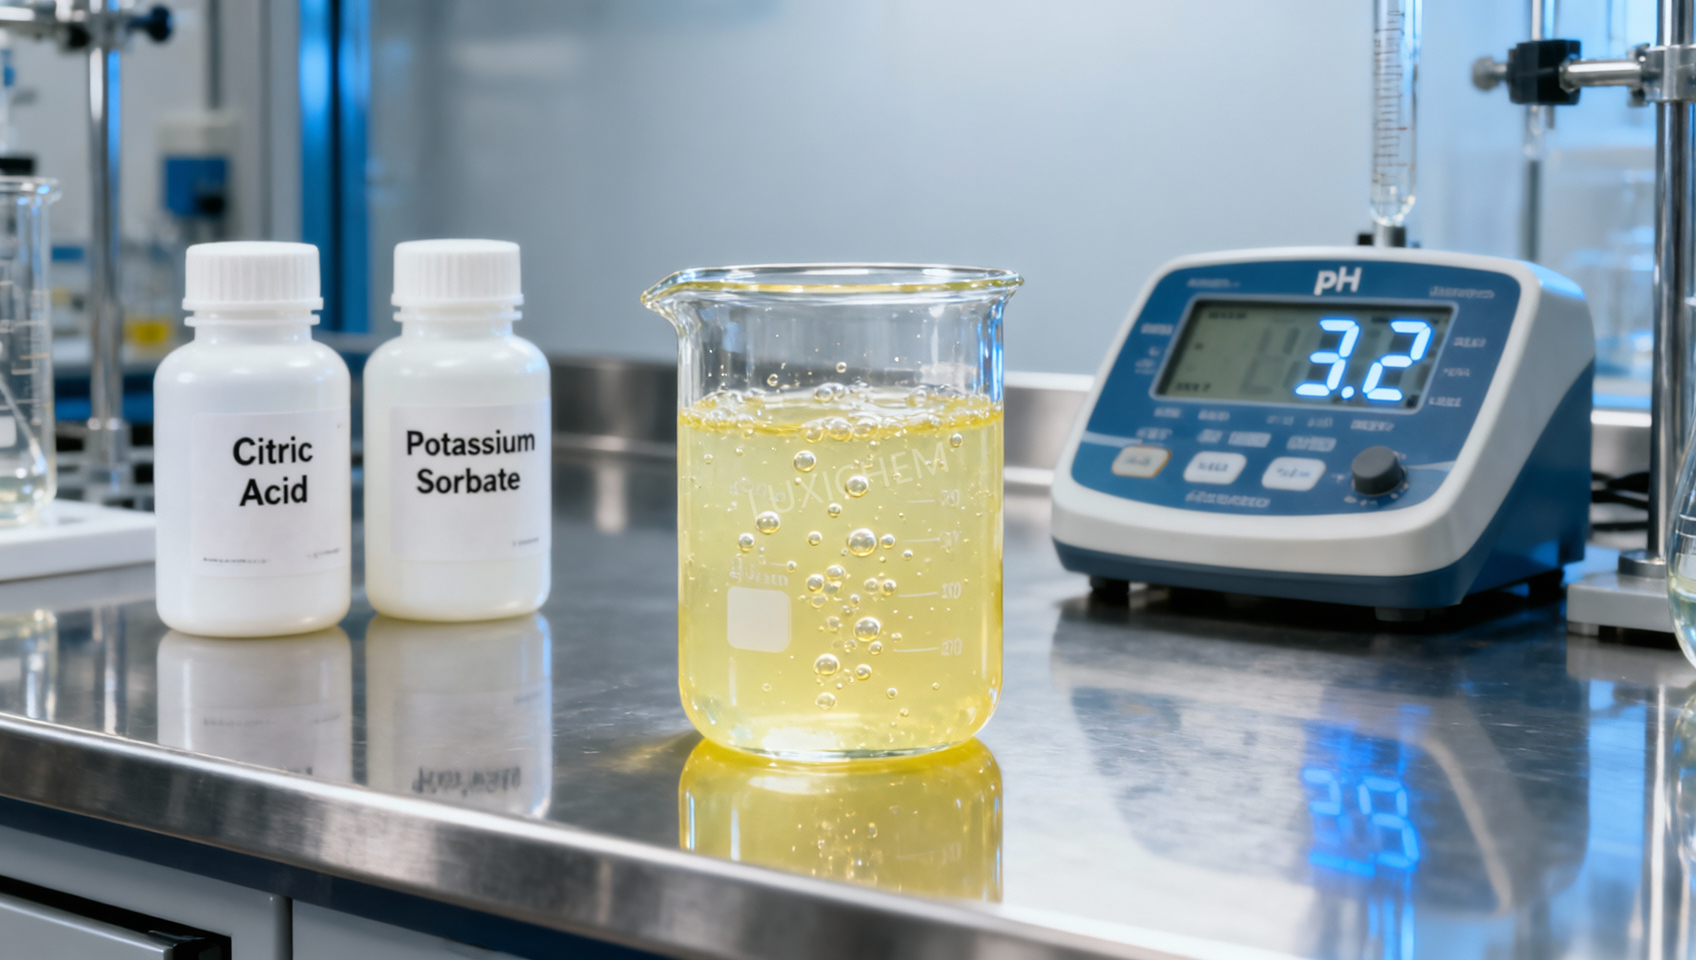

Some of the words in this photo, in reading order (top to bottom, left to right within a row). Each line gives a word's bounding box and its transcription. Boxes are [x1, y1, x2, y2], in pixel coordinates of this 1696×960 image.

[1313, 266, 1362, 296] pH
[1295, 318, 1432, 402] 3.2
[232, 436, 314, 466] Citric
[405, 429, 536, 456] Potassium
[239, 475, 308, 506] Acid
[416, 467, 521, 495] Sorbate
